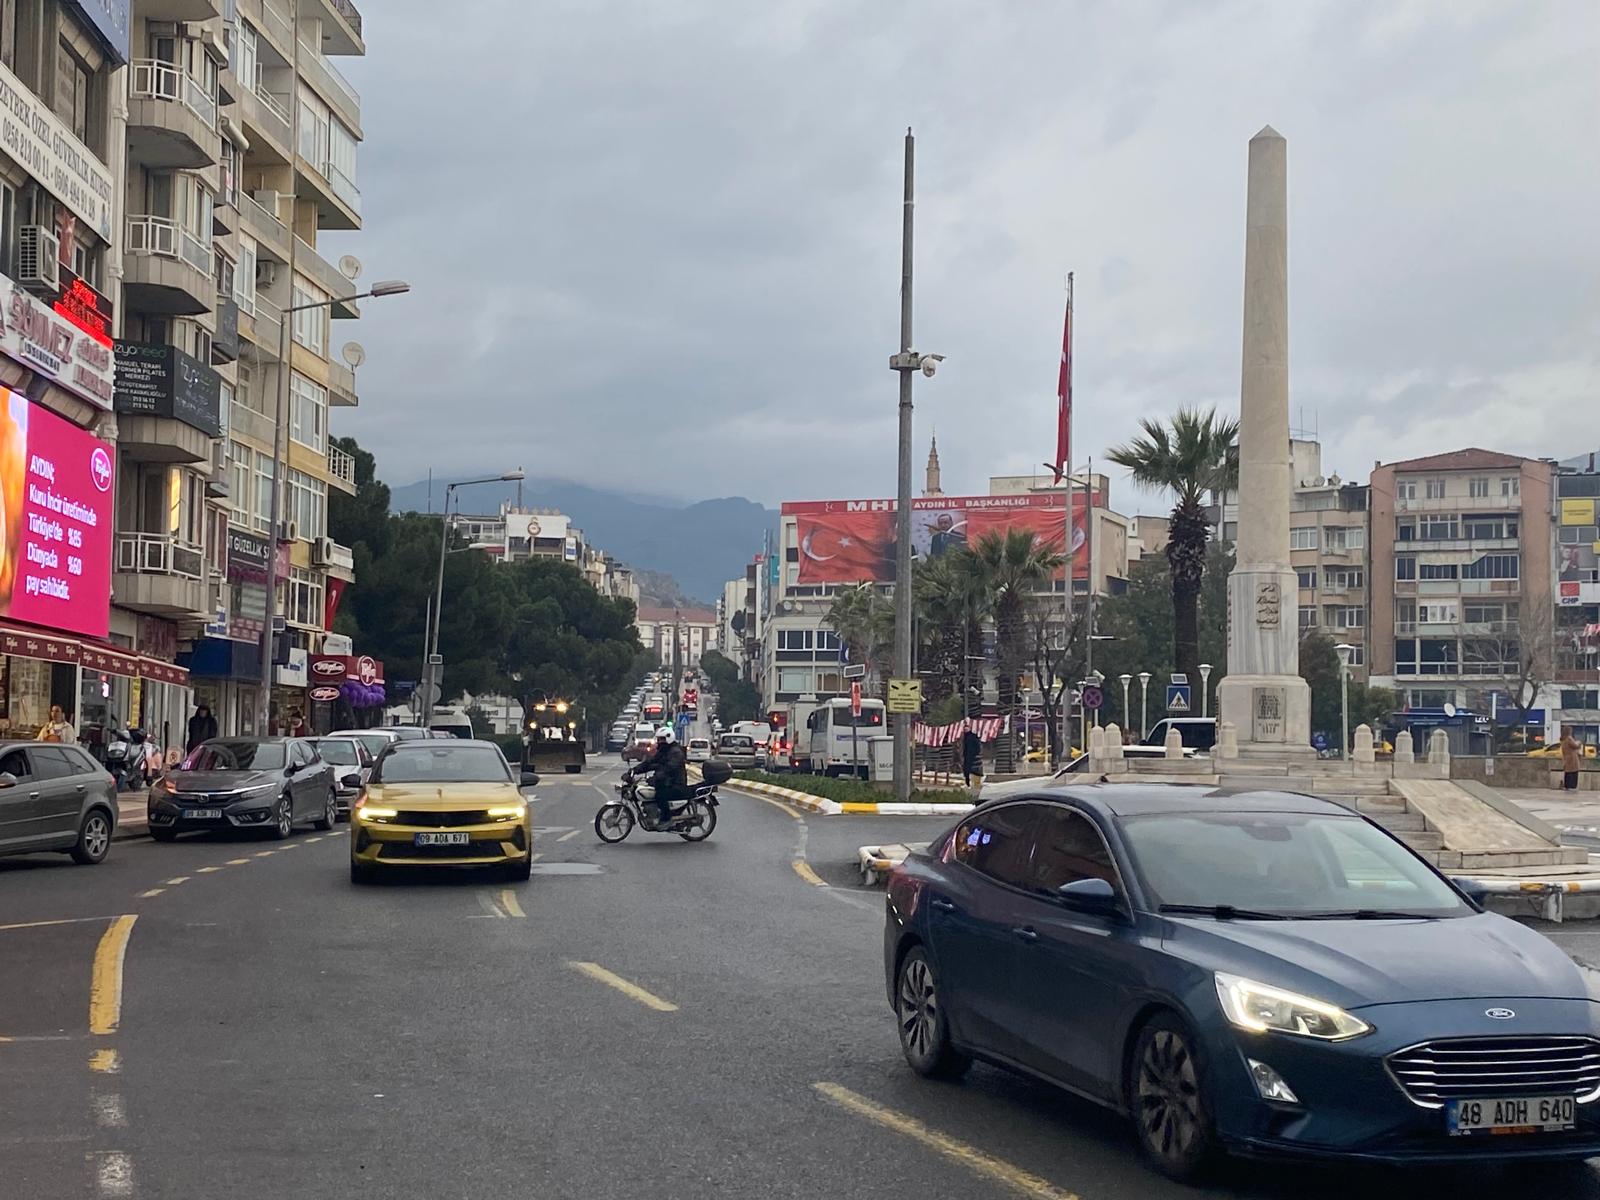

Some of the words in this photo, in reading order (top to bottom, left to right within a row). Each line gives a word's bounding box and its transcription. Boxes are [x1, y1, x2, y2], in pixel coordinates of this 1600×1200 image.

[31, 103, 51, 149] ÖZEL
[53, 130, 89, 184] GÜVENLİK
[29, 484, 46, 508] Kuru
[62, 497, 97, 527] üretiminde
[914, 500, 945, 509] AYDIN
[948, 499, 958, 508] İL
[965, 497, 1029, 509] BAŞKANLIĞI
[28, 512, 63, 542] Türkiye'de
[27, 542, 58, 568] Dünyada
[26, 574, 40, 596] pay
[1562, 597, 1579, 605] CHP
[1460, 1102, 1481, 1125] 48
[1494, 1101, 1528, 1124] ADH
[1540, 1099, 1573, 1121] 640
